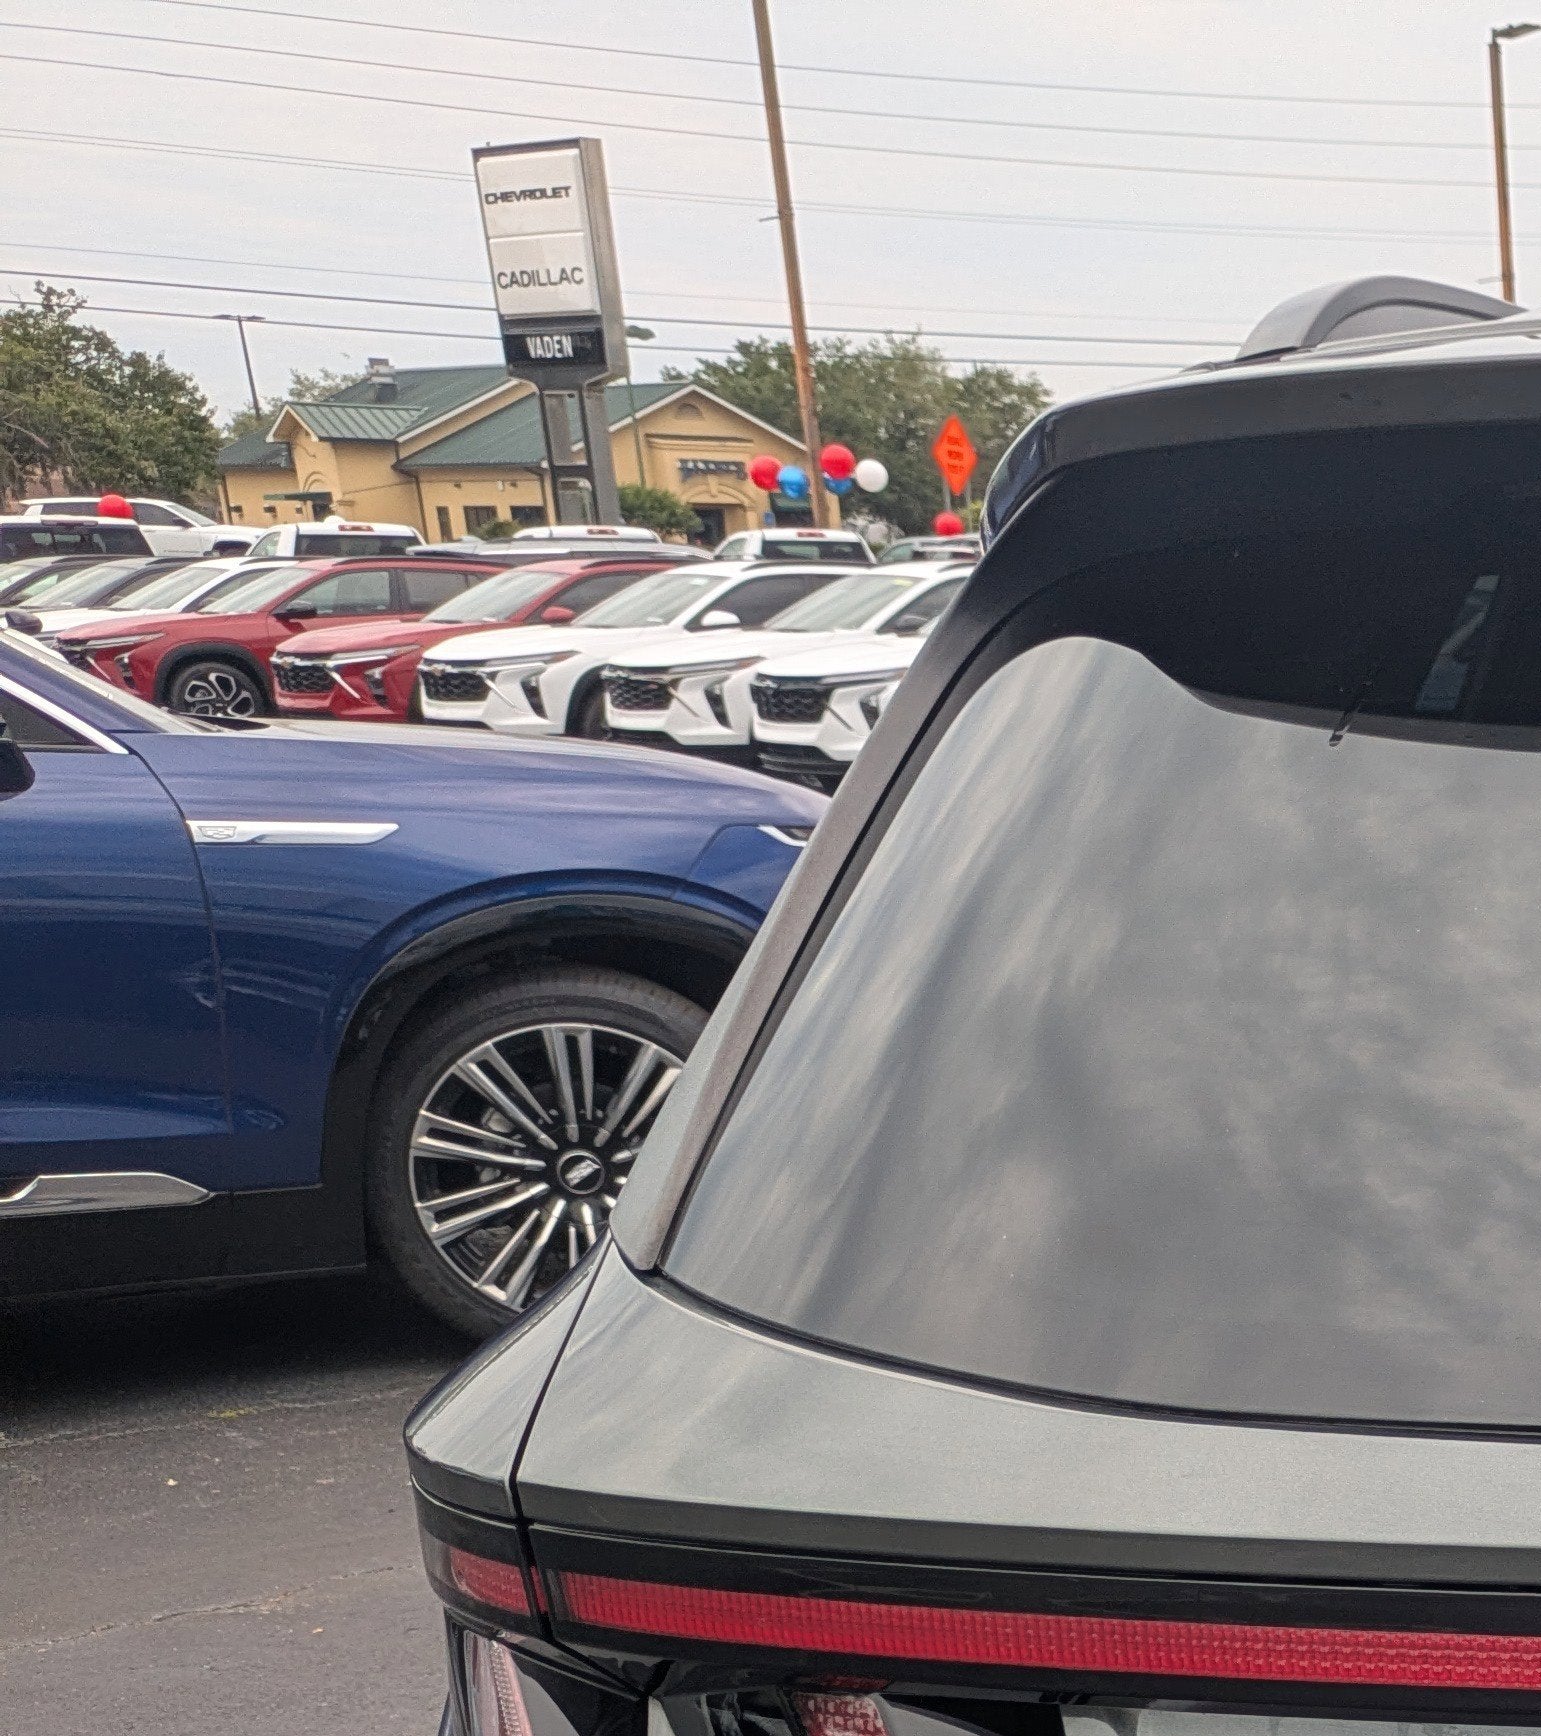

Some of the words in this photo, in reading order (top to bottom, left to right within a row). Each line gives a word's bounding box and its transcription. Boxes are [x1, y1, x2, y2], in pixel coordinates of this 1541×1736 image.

[485, 186, 571, 205] CHEVROLET
[497, 267, 584, 289] CADILLAC
[525, 335, 574, 359] VADEN
